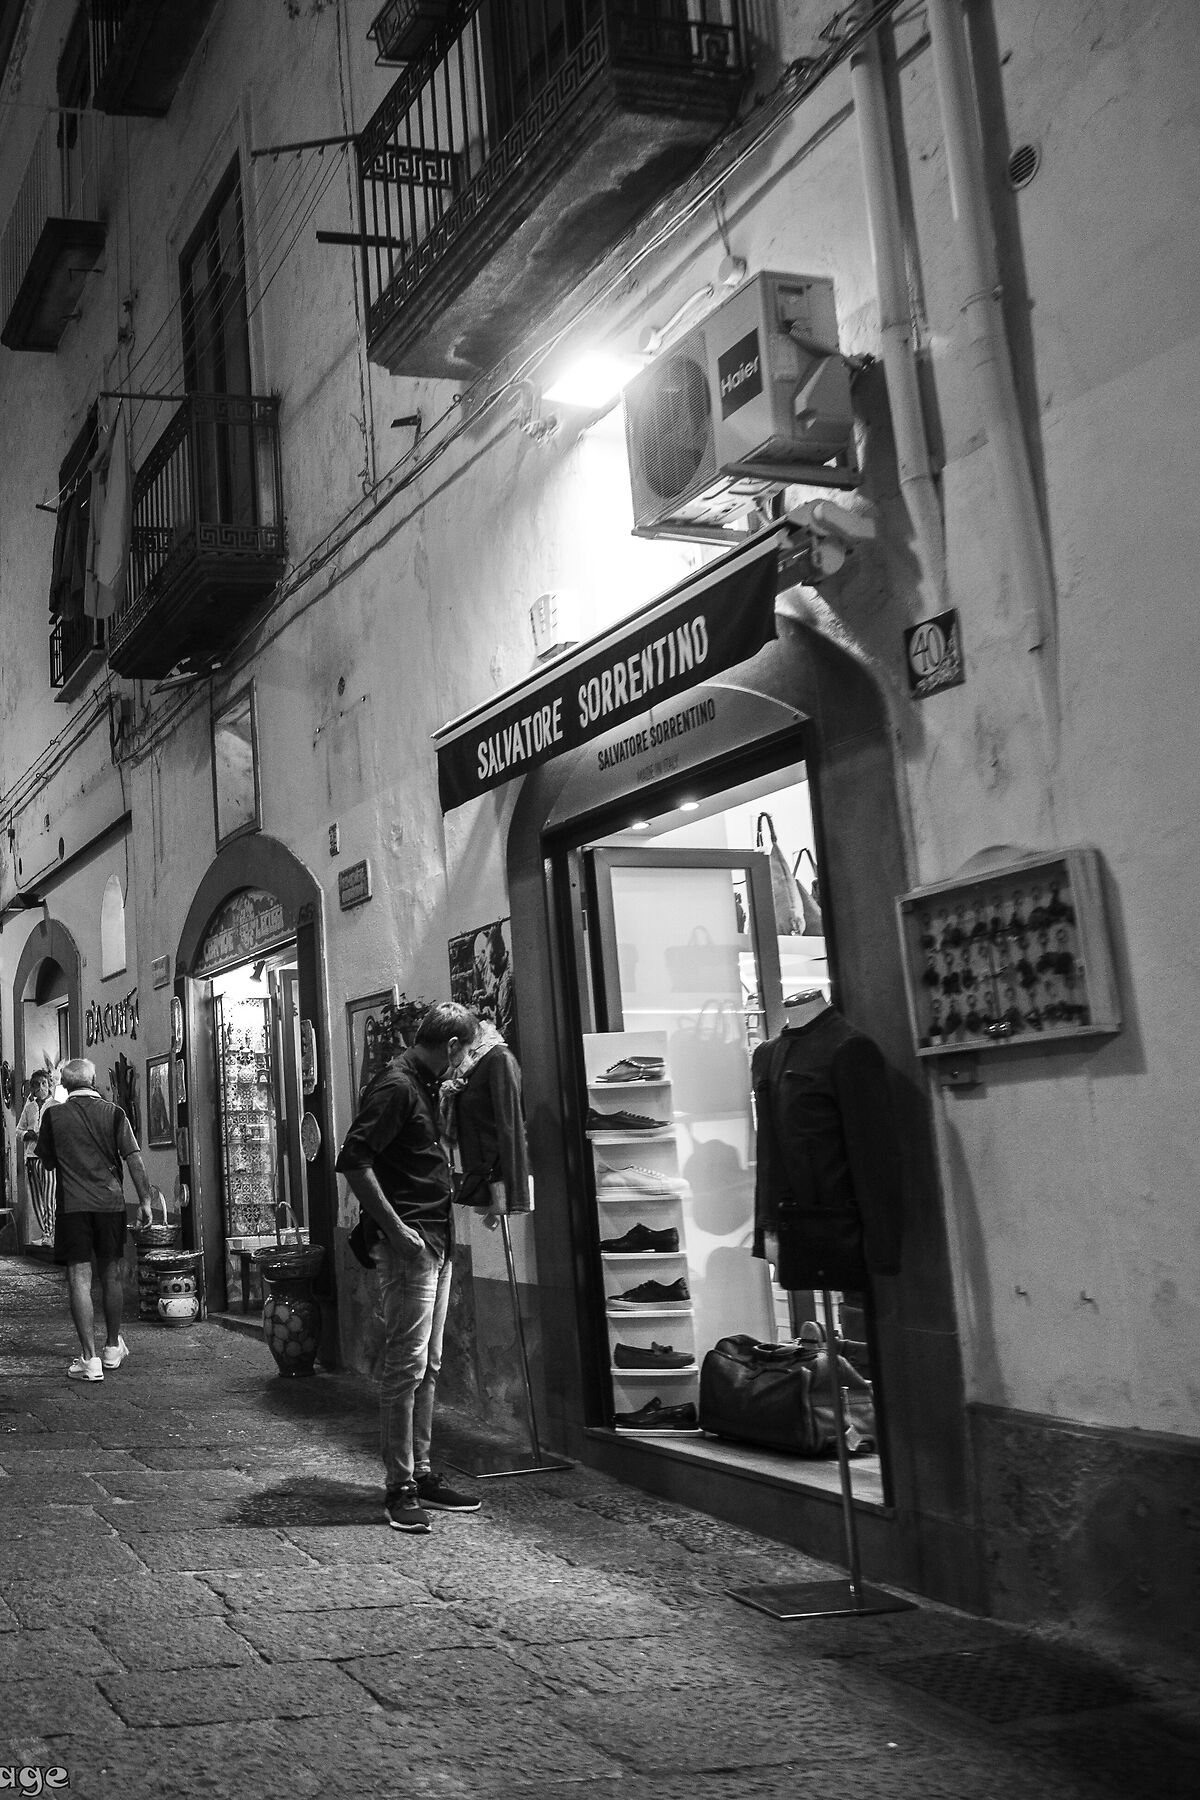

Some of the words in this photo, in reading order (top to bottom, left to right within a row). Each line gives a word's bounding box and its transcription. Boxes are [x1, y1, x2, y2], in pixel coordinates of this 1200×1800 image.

[721, 355, 759, 399] Haier
[477, 697, 564, 781] SALVATORE
[578, 615, 709, 729] SORRENTINO
[598, 730, 649, 771] SALVATORE
[650, 698, 716, 748] SORRENTINO
